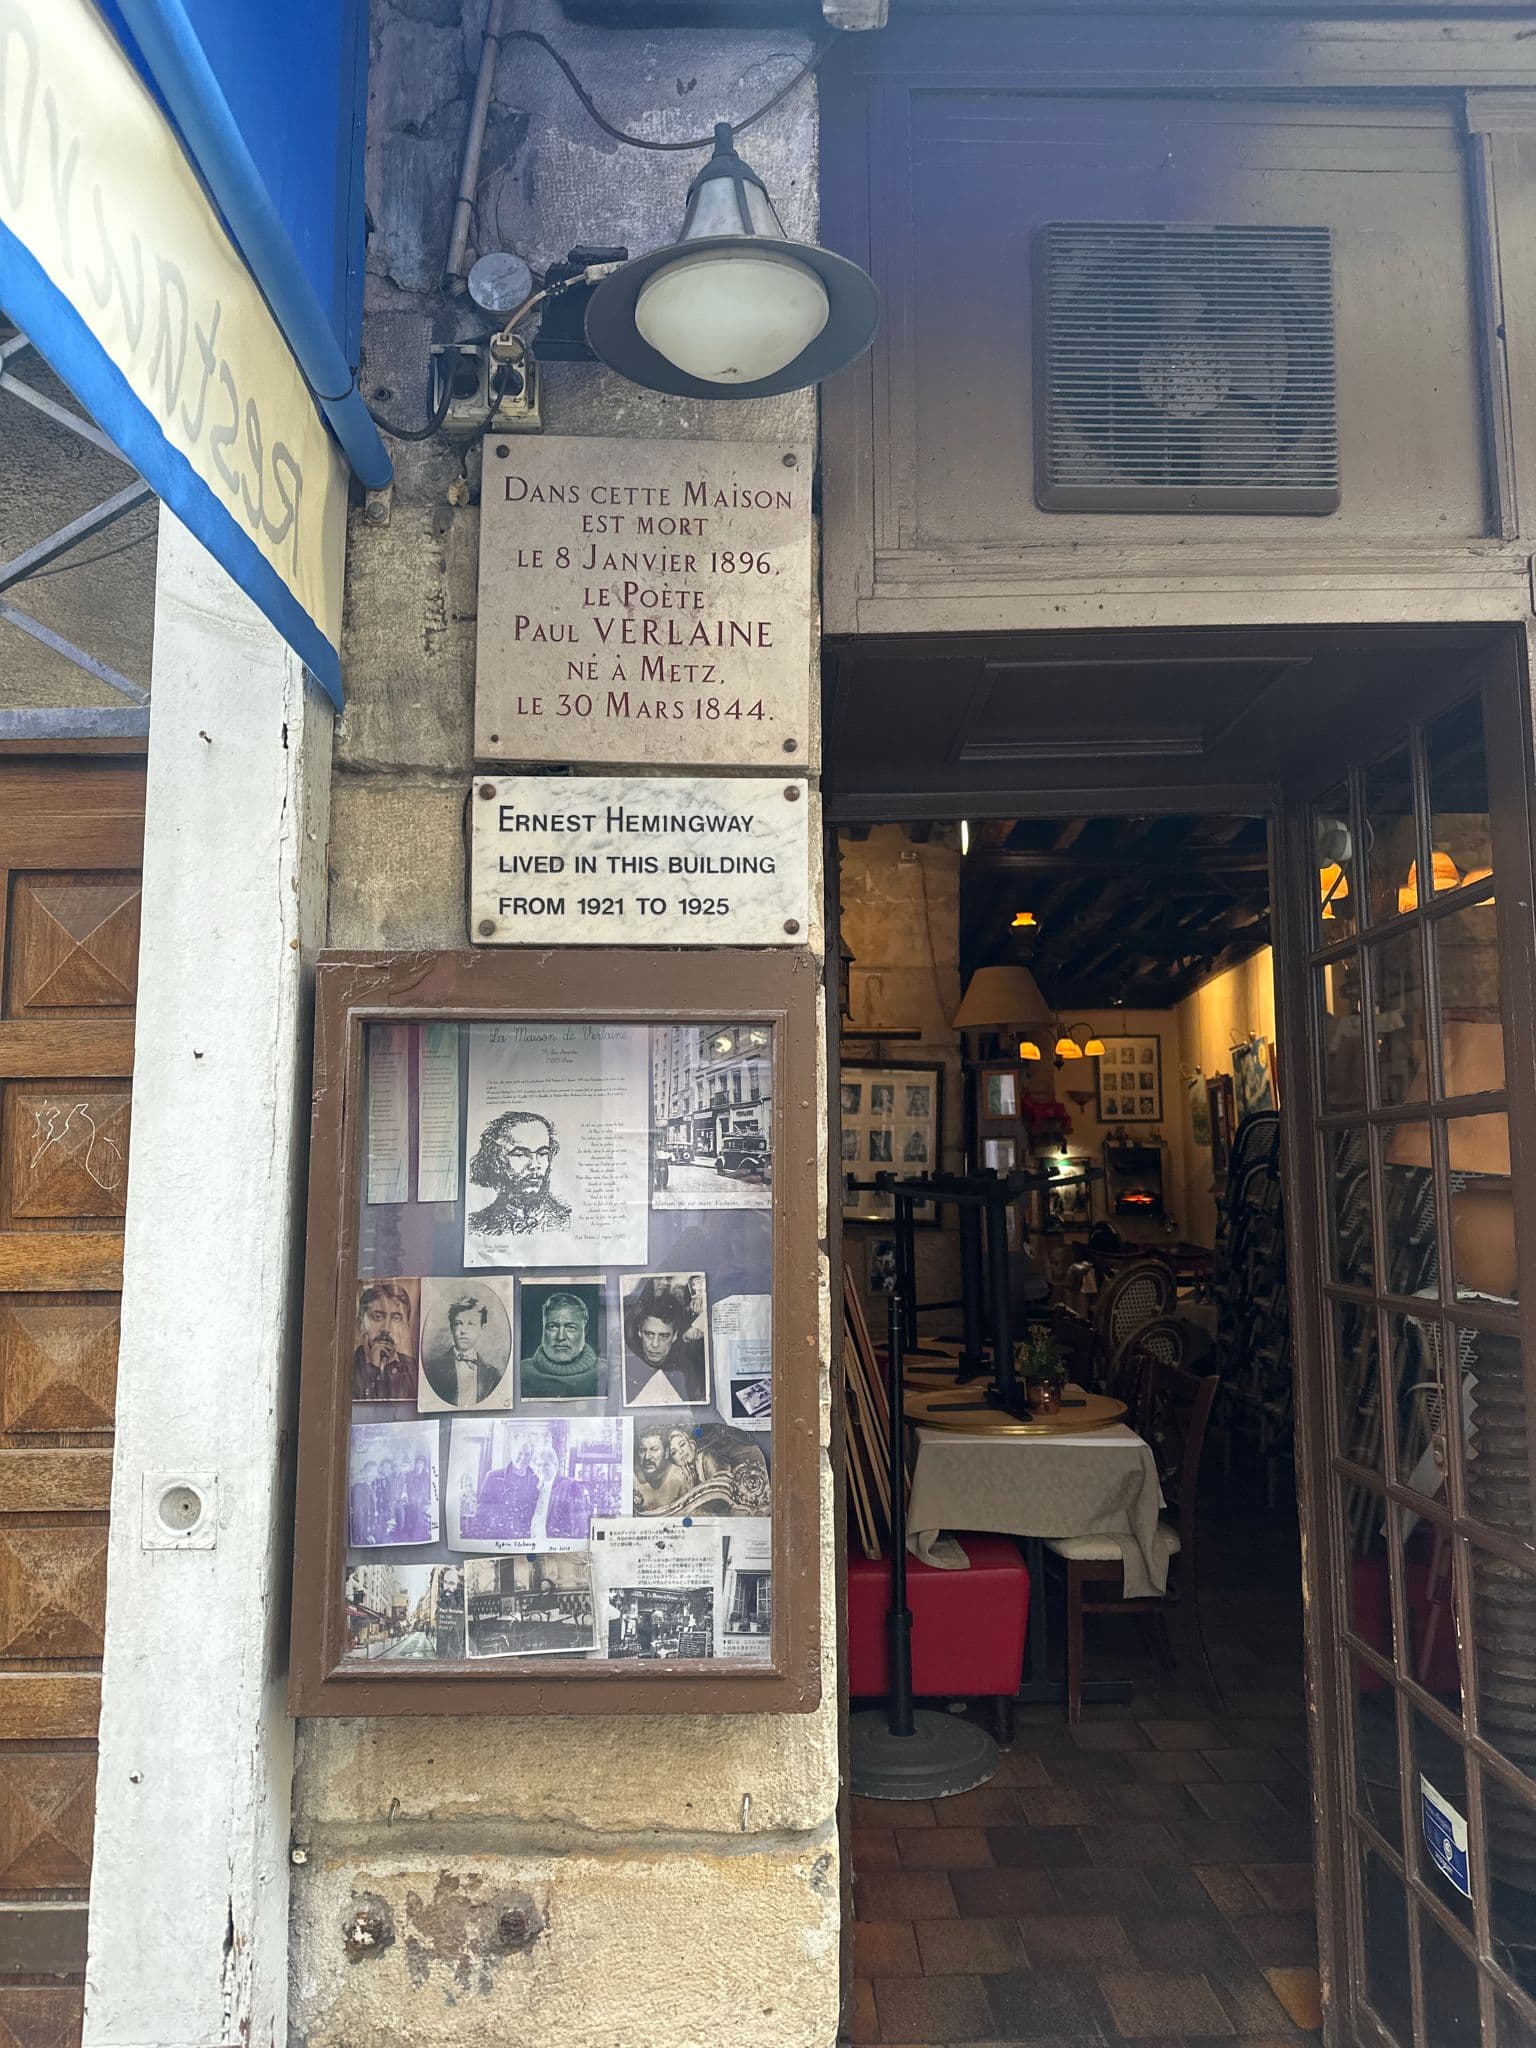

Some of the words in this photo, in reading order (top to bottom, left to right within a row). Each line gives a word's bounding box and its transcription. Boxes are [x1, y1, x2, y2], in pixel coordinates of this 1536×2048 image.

[505, 476, 579, 503] DANS
[591, 487, 670, 505] CETTE
[684, 481, 791, 509] MAISON
[583, 515, 624, 533] EST
[638, 517, 708, 535] MORT
[519, 550, 542, 567] LE
[556, 547, 569, 568] 8
[583, 544, 696, 572] JANVIER
[585, 588, 610, 606] LE
[620, 581, 704, 609] POÈTE
[515, 615, 579, 642] PAUL
[593, 618, 772, 647] VERLAINE
[568, 654, 598, 680] NÉ
[612, 655, 626, 680] À
[518, 697, 542, 715] LE
[556, 695, 592, 716] 30
[607, 692, 683, 719] MARS
[697, 698, 773, 720] 1844.
[500, 805, 596, 832] ERNEST
[607, 807, 753, 833] HEMINGWAY
[500, 856, 564, 873] LIVED
[576, 857, 596, 873] IN
[607, 857, 658, 873] THIS
[669, 857, 775, 873] BUILDING
[500, 898, 564, 914] FROM
[578, 898, 623, 915] 1921
[636, 898, 666, 915] TO
[679, 898, 729, 915] 1925
[490, 1028, 507, 1043] La
[513, 1027, 557, 1041] Maison
[563, 1027, 576, 1041] de
